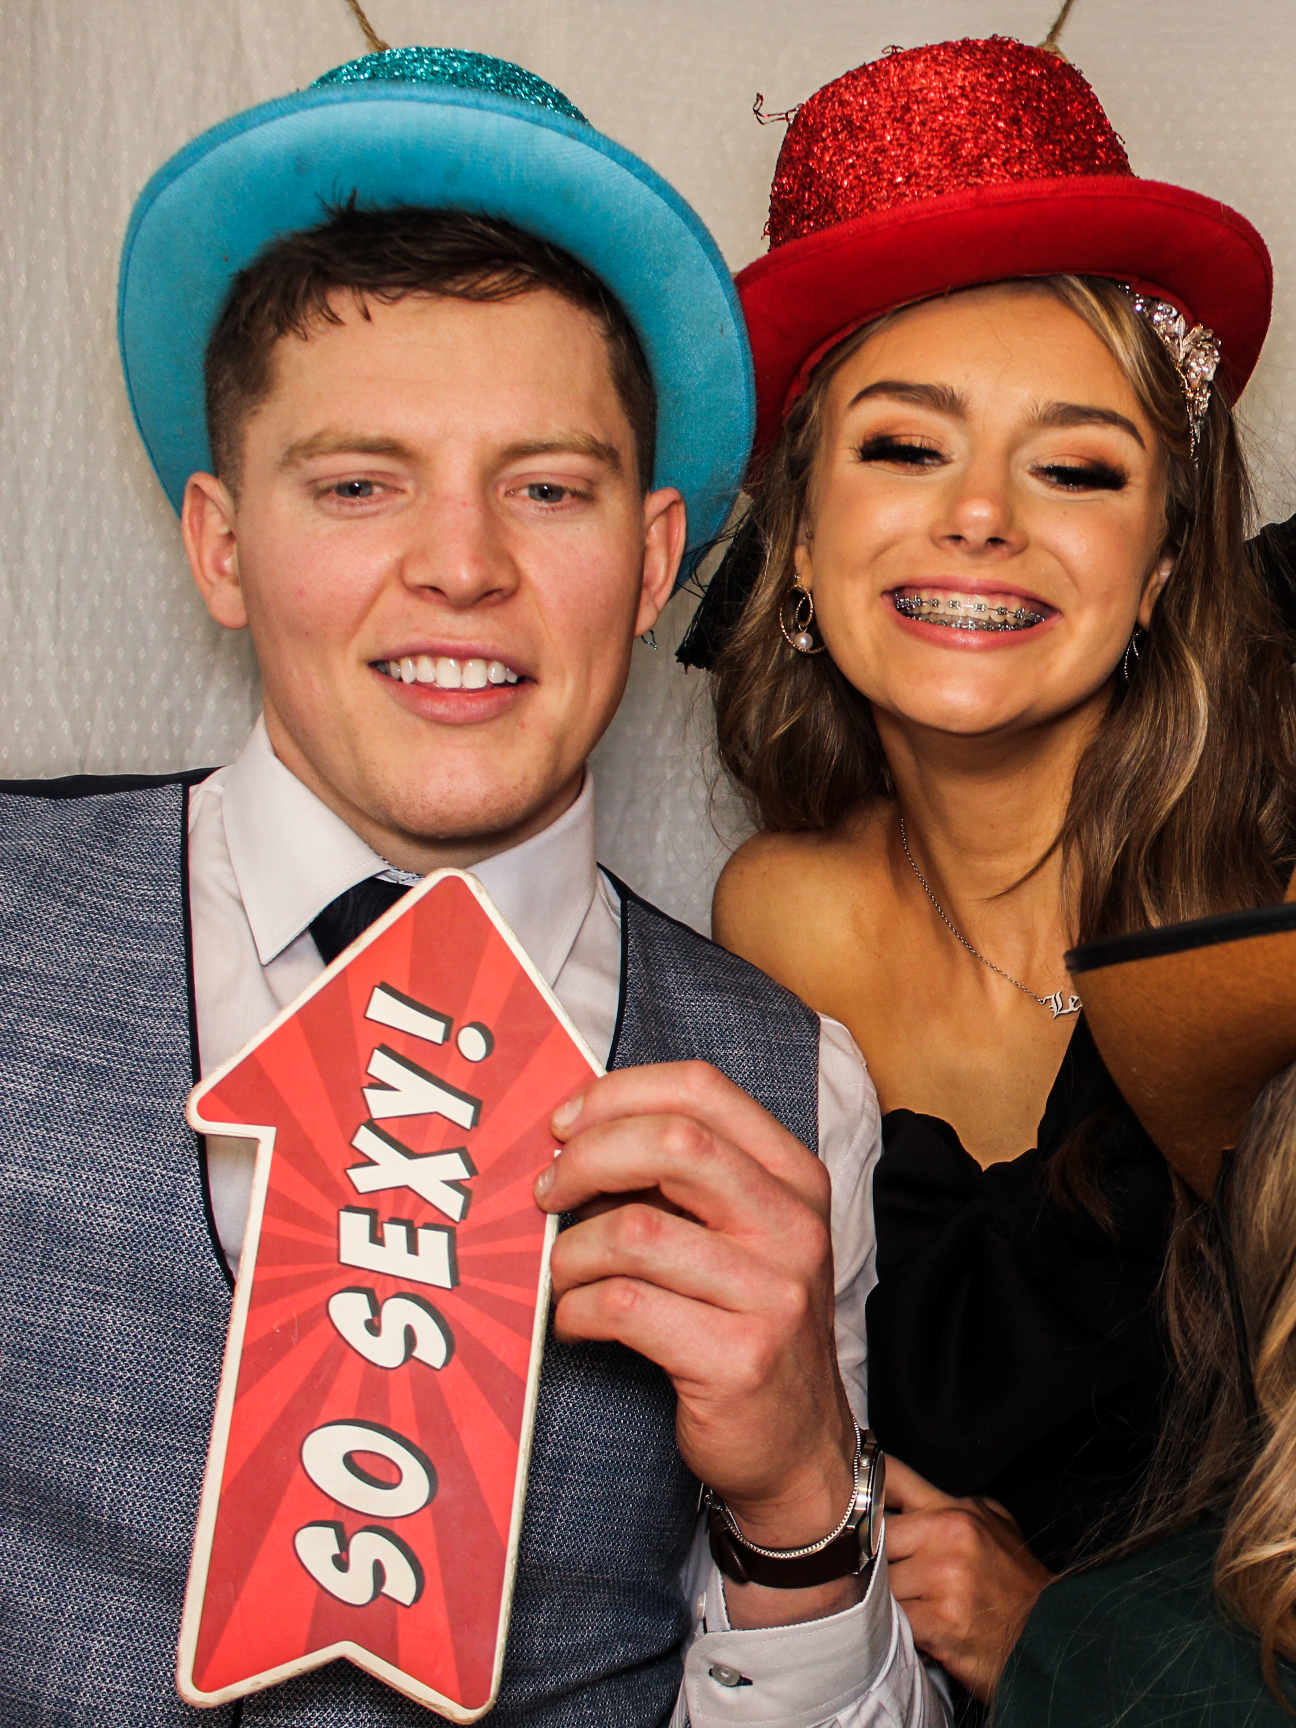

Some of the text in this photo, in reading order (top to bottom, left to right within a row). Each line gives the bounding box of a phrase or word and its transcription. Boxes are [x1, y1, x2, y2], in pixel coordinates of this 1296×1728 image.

[1041, 990, 1083, 1020] Le
[294, 980, 495, 1610] SO SEXY!
